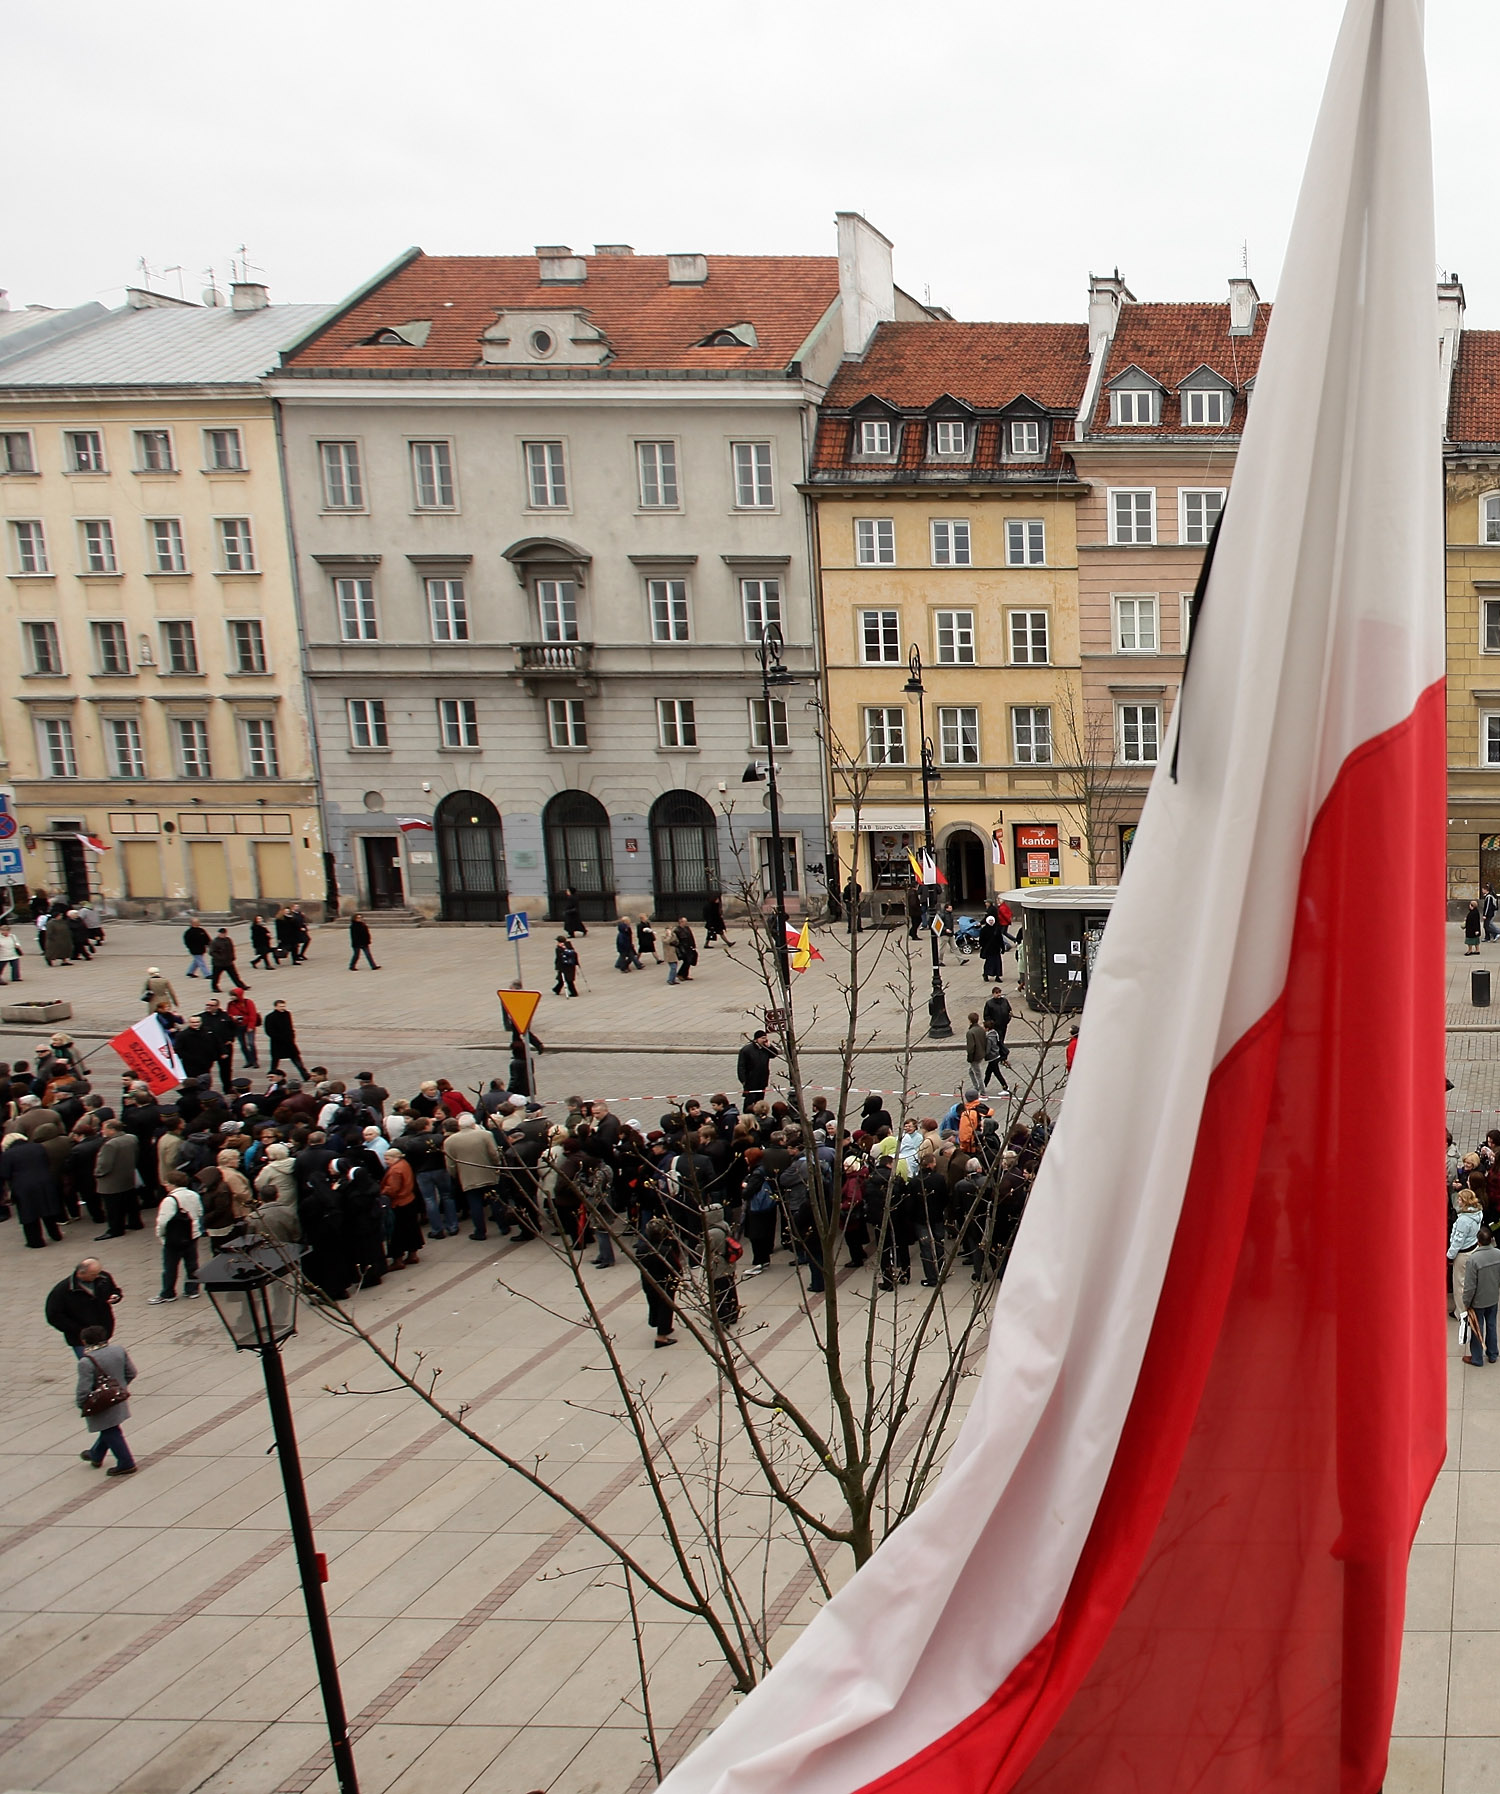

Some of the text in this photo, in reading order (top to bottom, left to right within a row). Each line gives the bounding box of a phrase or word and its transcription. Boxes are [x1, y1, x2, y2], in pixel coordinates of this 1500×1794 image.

[1021, 836, 1056, 846] kantor
[0, 851, 17, 872] P
[128, 1041, 169, 1083] SZCZECIN
